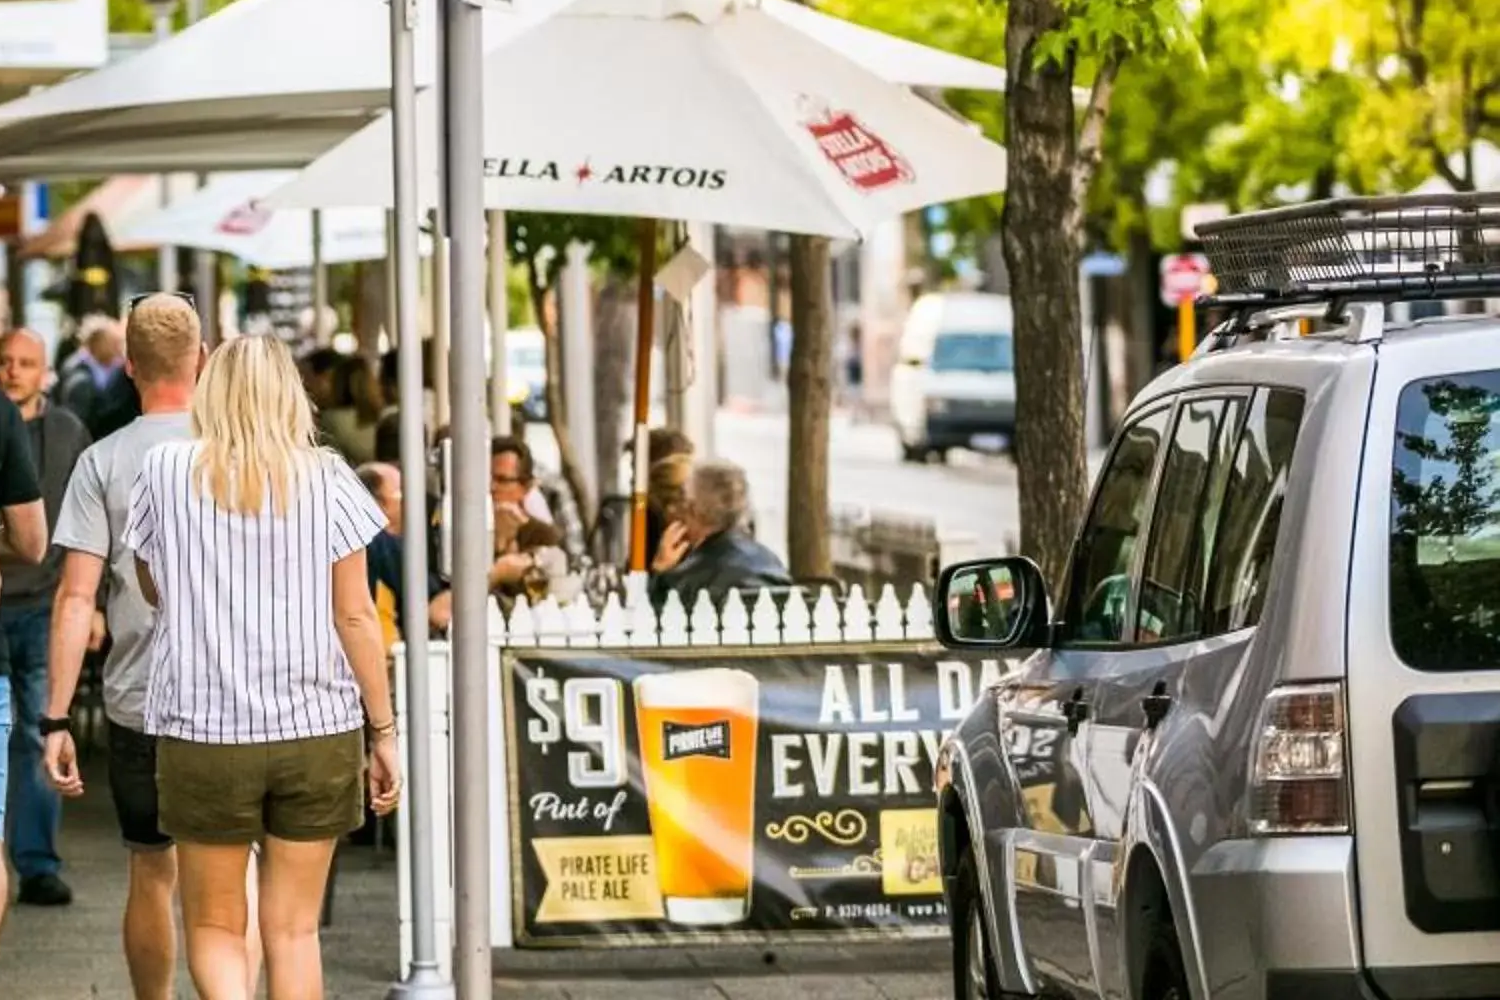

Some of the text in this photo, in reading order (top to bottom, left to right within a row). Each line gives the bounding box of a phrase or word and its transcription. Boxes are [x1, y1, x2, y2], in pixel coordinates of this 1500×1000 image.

[483, 158, 727, 190] ELLA ARTOIS
[818, 659, 1023, 724] ALL DA
[526, 667, 628, 789] $9
[528, 790, 627, 831] Pint of
[560, 853, 650, 876] PIRATE LIFE
[561, 879, 630, 900] PALE ALE
